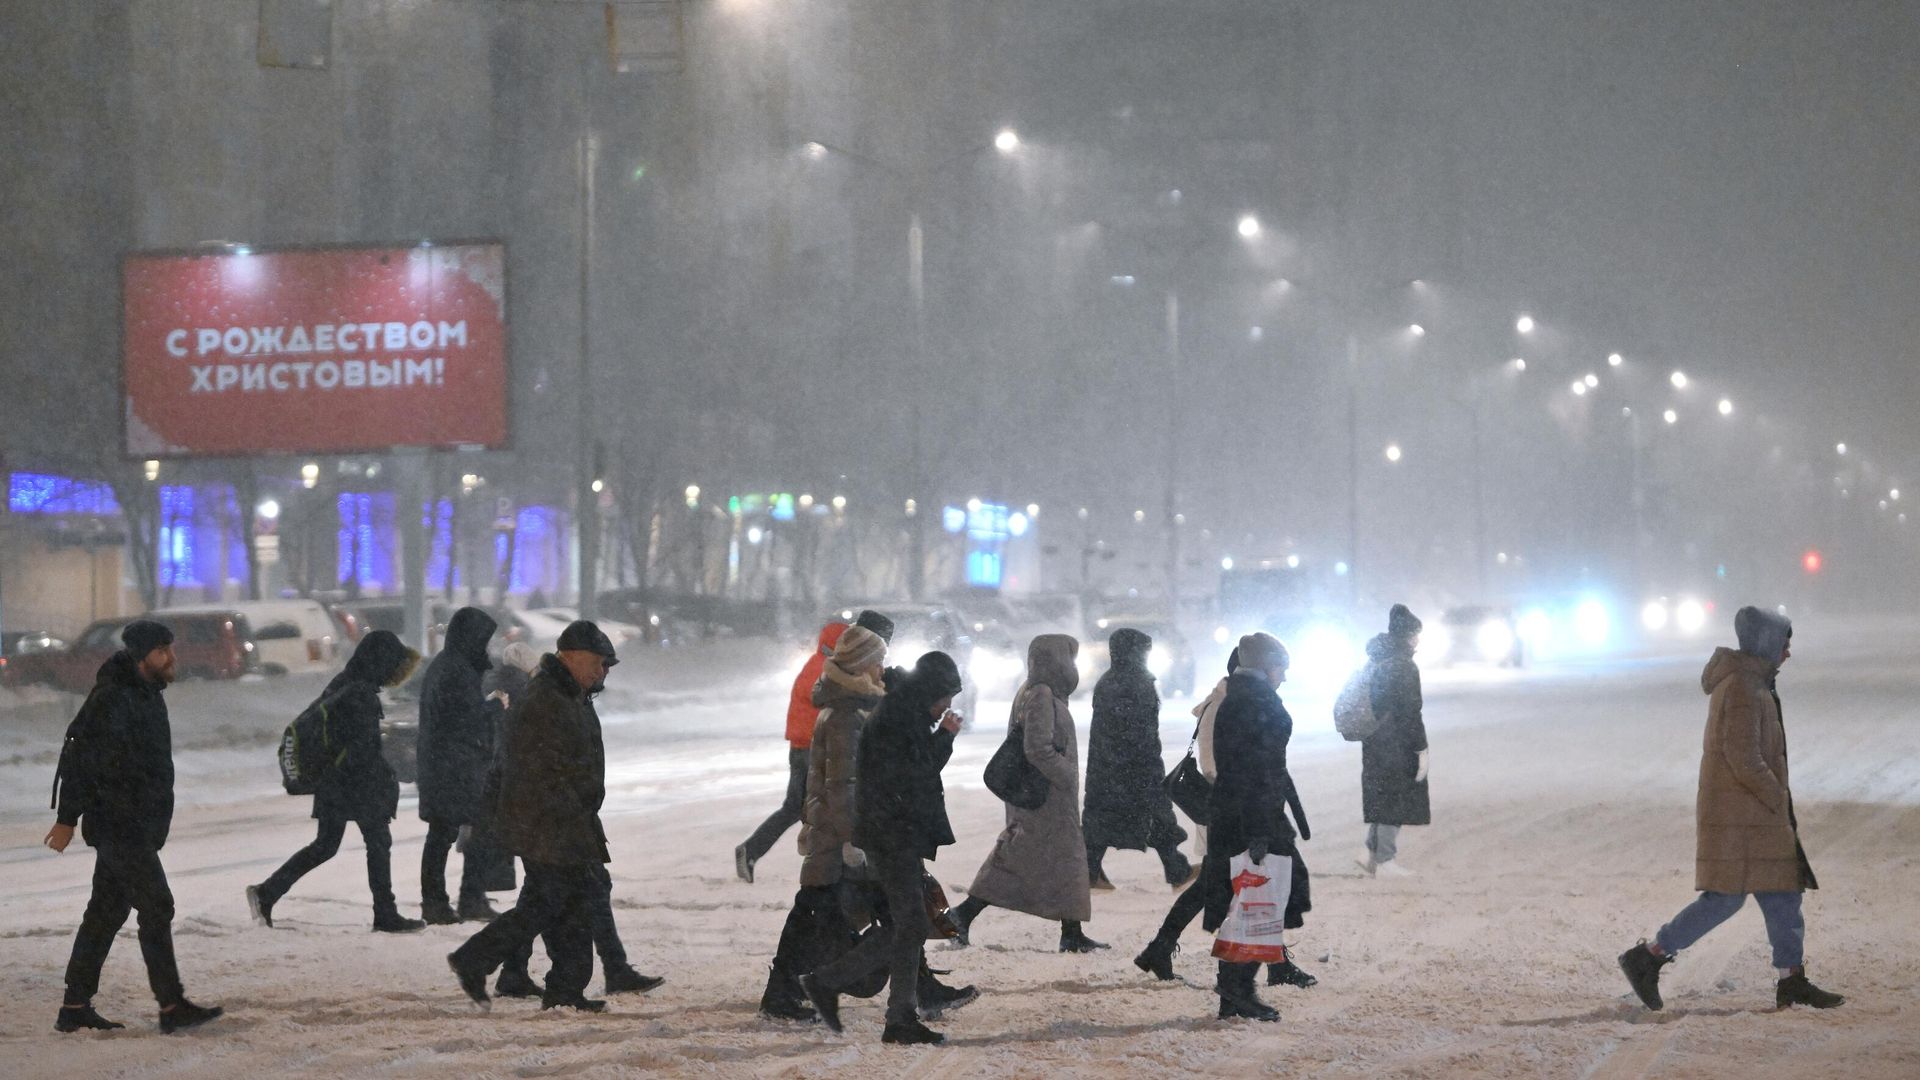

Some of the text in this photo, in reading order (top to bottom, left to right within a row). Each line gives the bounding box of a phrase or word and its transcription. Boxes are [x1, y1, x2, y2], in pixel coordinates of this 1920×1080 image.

[166, 321, 467, 356] С РОЖДЕСТВОМ
[190, 358, 445, 392] ХРИСТОВЫМ!
